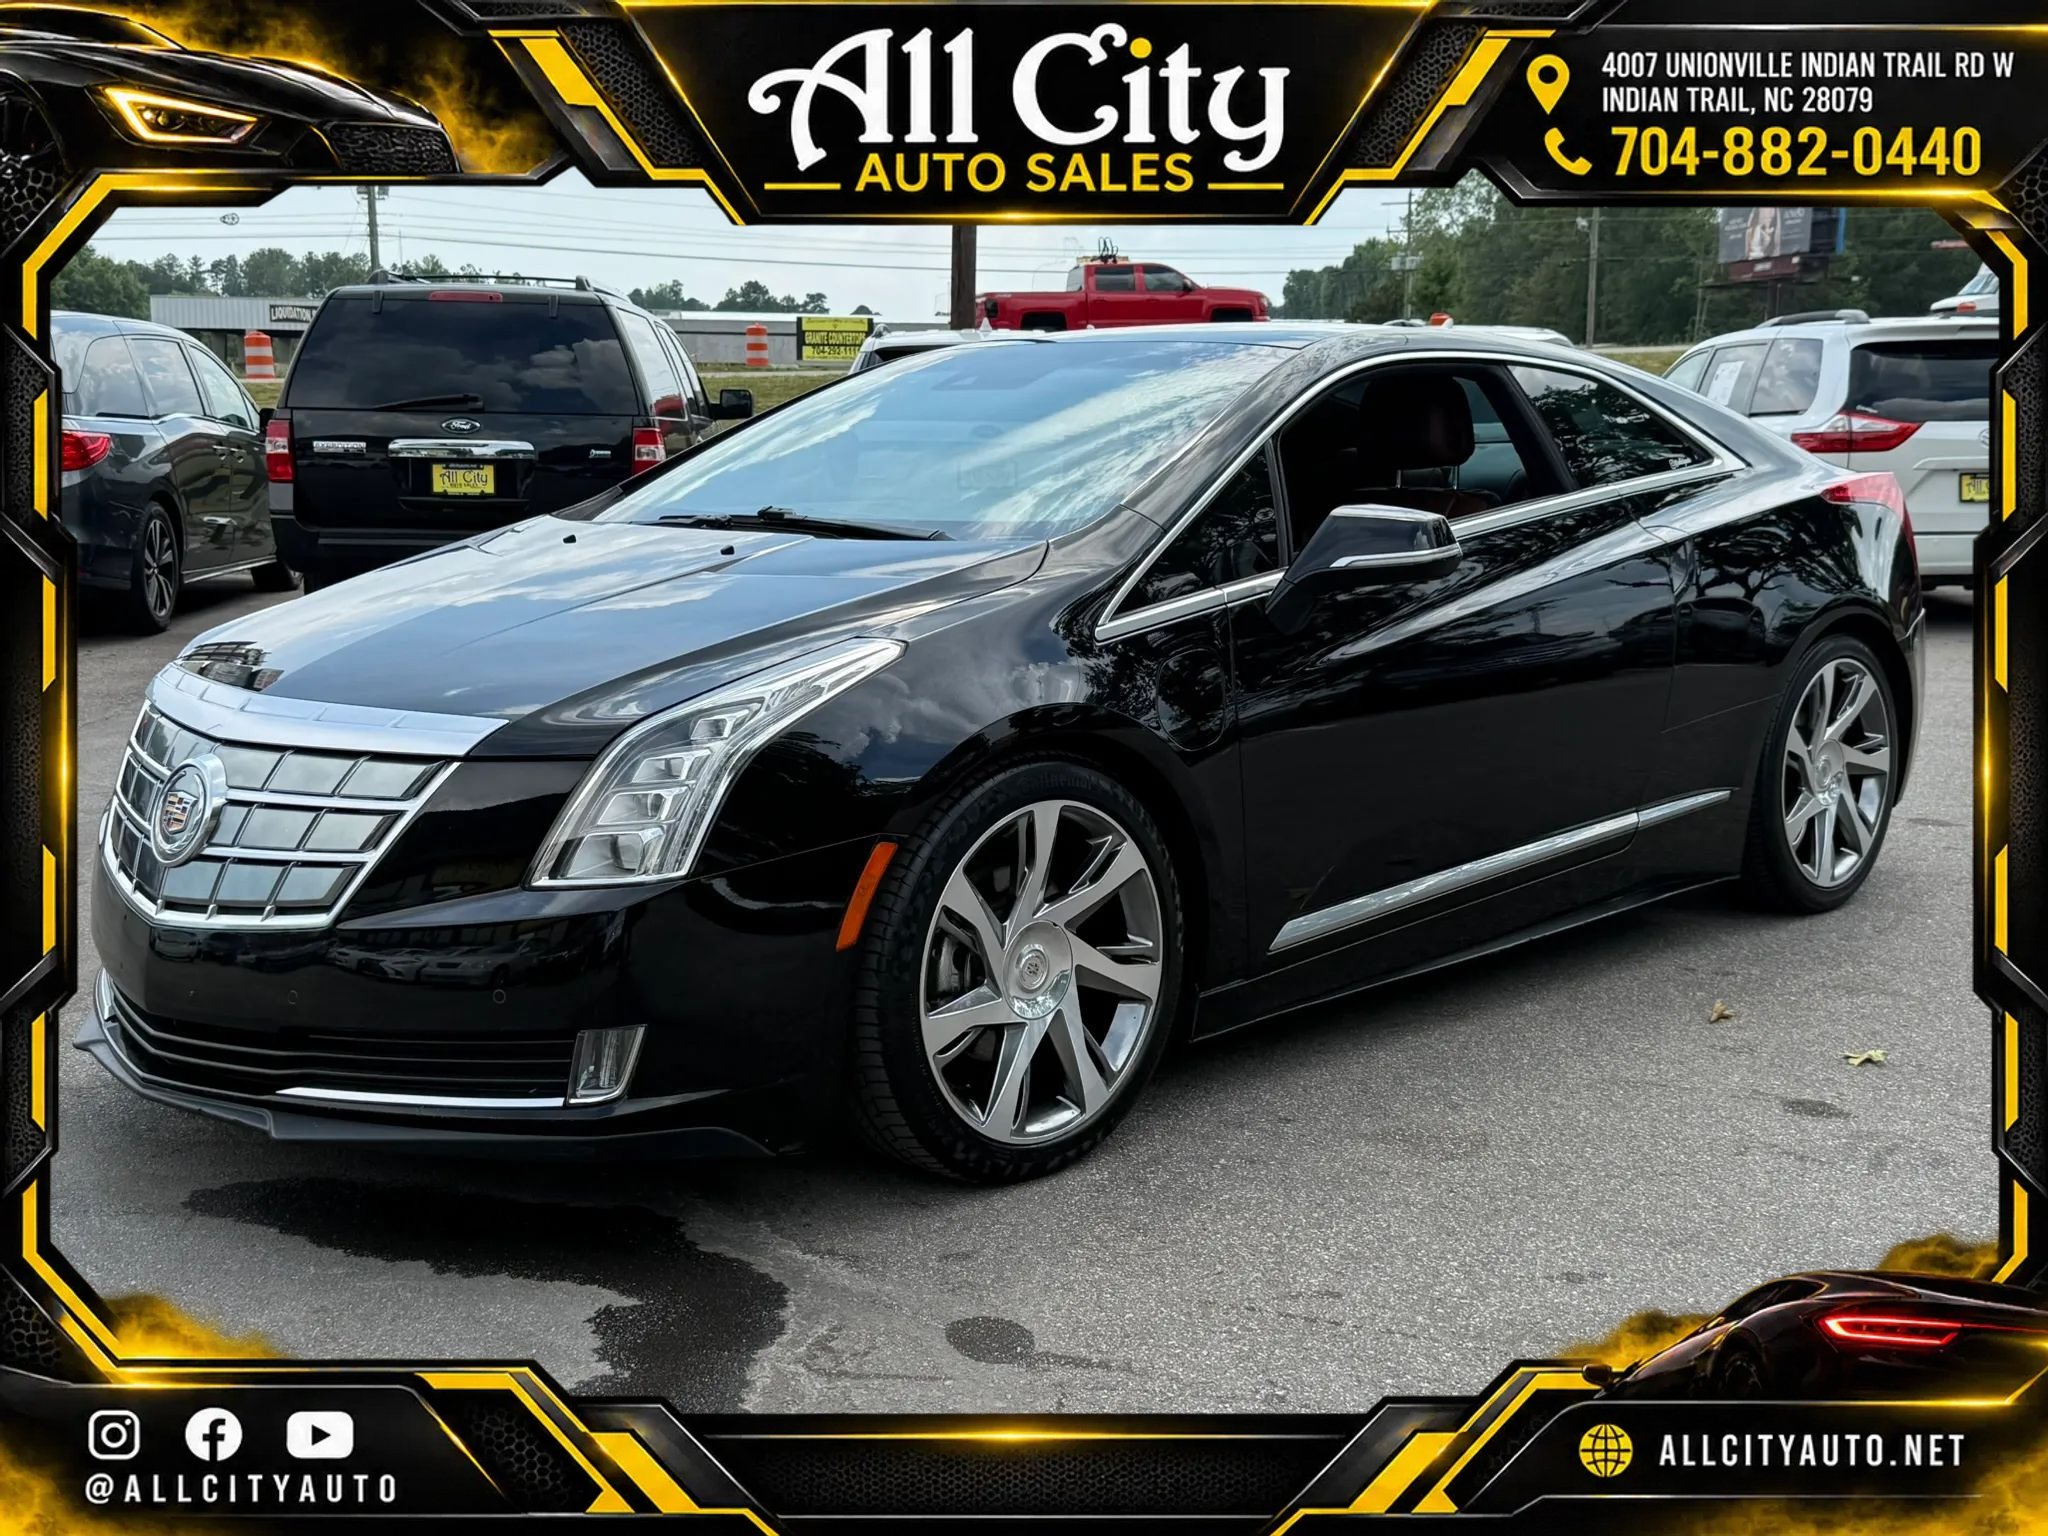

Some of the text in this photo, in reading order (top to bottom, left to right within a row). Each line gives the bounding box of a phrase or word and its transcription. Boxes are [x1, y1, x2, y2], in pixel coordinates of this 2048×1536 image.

[271, 306, 311, 321] LIQUIDATION
[805, 331, 828, 345] GRANITE
[439, 470, 488, 487] All City
